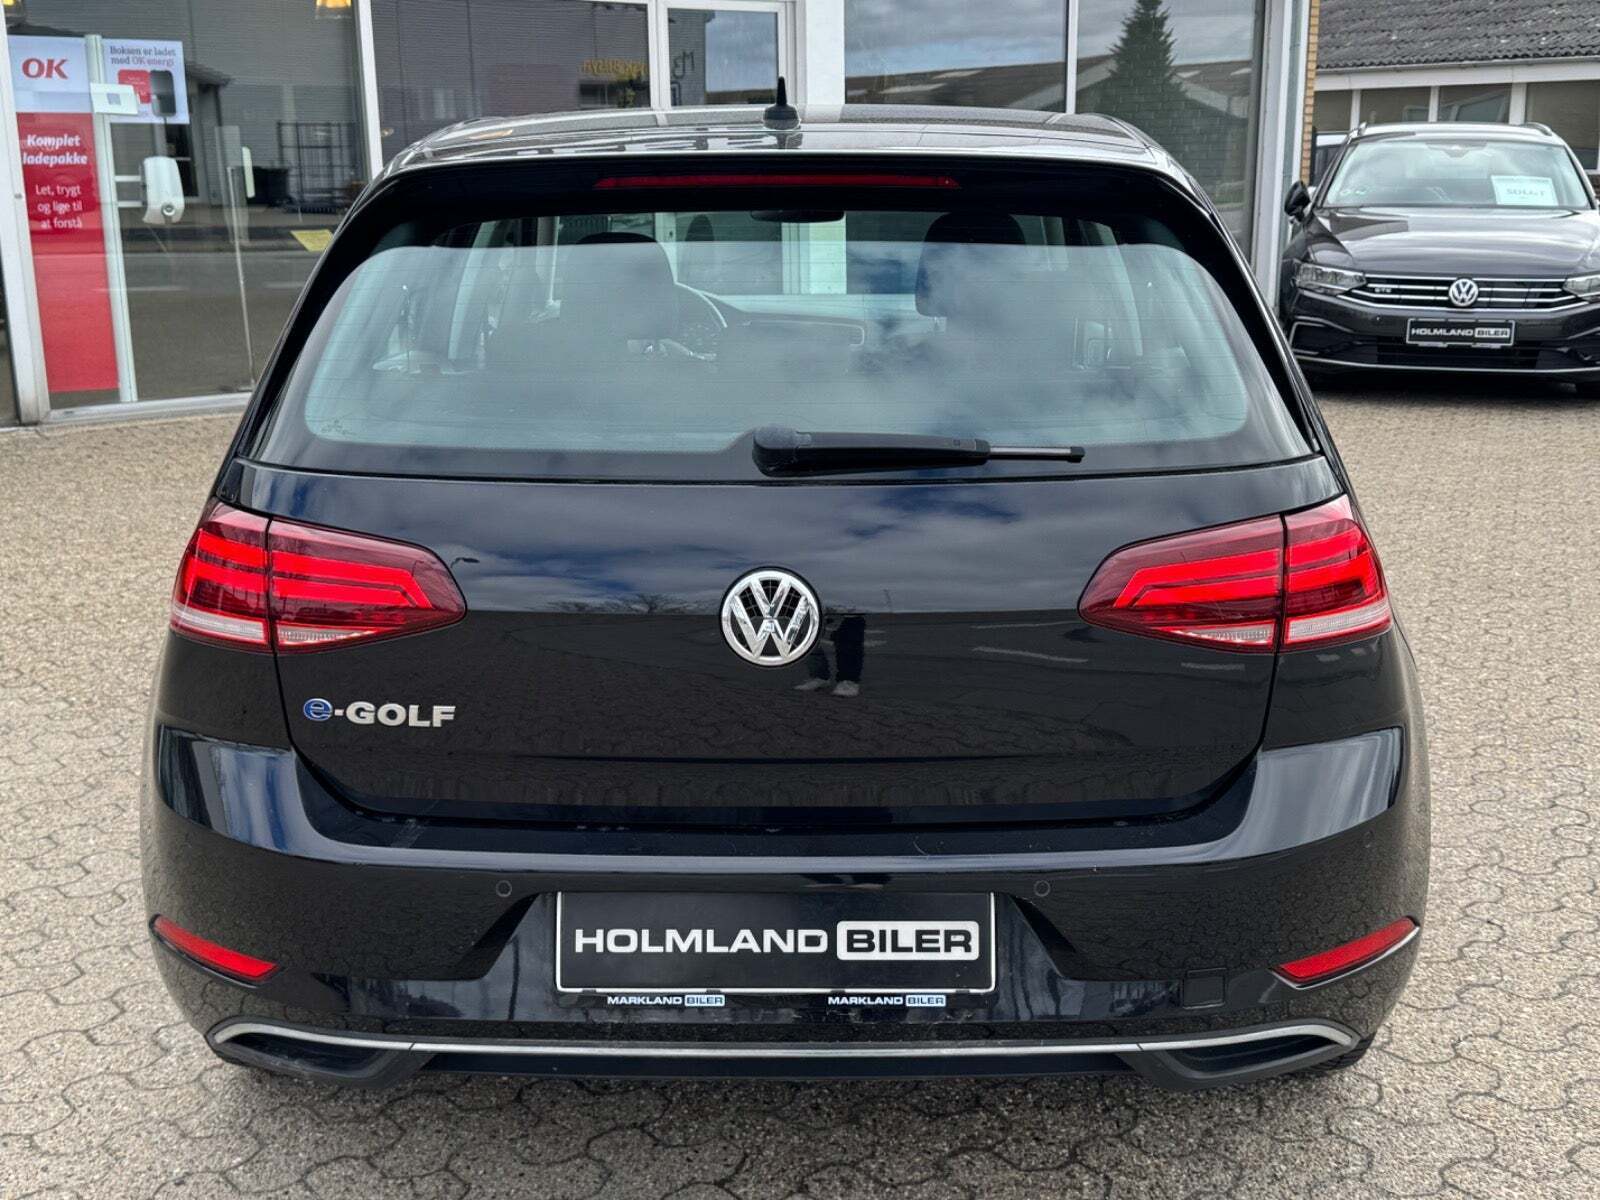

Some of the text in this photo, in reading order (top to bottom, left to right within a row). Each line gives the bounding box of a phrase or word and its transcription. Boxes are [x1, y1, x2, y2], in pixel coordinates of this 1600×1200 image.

[111, 56, 130, 65] med
[22, 58, 68, 80] OK
[27, 134, 80, 149] Komplet
[23, 152, 88, 168] ladepakke
[35, 184, 81, 198] Let, trygt
[37, 200, 83, 214] og lige til
[53, 216, 82, 228] forstå
[1411, 327, 1474, 337] HOLMLAND
[575, 929, 972, 953] HOLMLAND BILER
[607, 996, 724, 1005] MARKLAND BILER
[828, 996, 945, 1005] MARKLAND BILER
